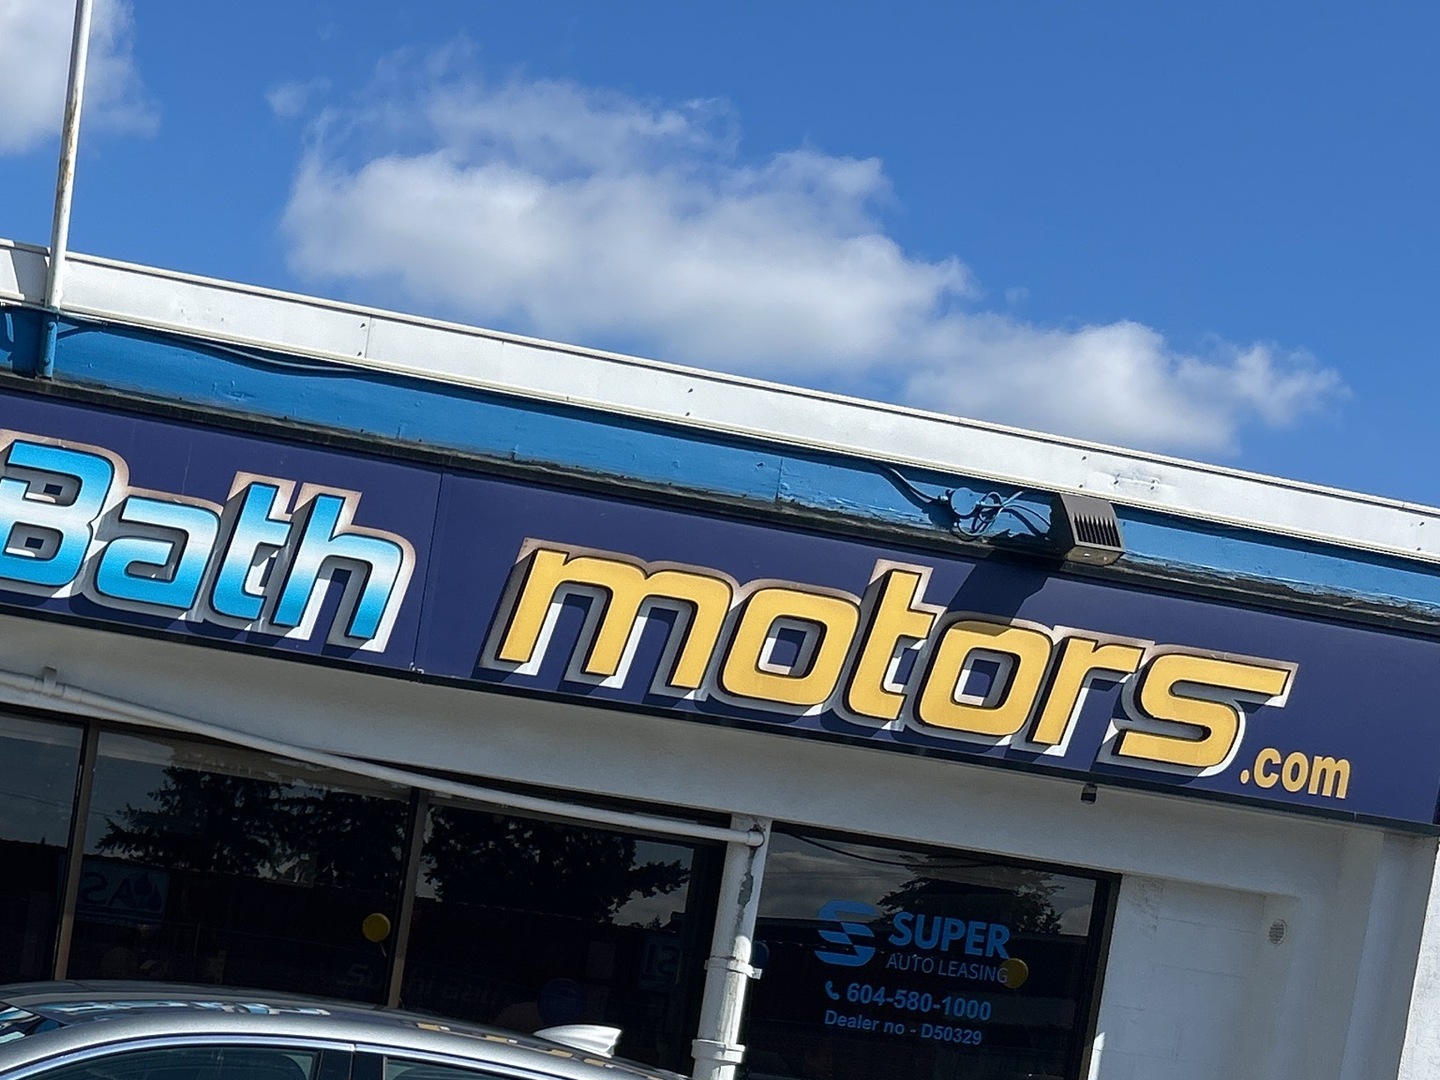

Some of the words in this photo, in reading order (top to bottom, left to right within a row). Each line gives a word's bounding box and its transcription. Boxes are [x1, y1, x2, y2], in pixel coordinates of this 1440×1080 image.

[479, 537, 1298, 778] motors
[888, 911, 1010, 959] SUPER
[886, 952, 935, 975] AUTO
[938, 958, 1009, 984] LEASING
[846, 982, 992, 1021] 604-580-1000
[824, 1009, 878, 1032] Dealer
[884, 1021, 905, 1036] no
[920, 1023, 983, 1045] D50329
